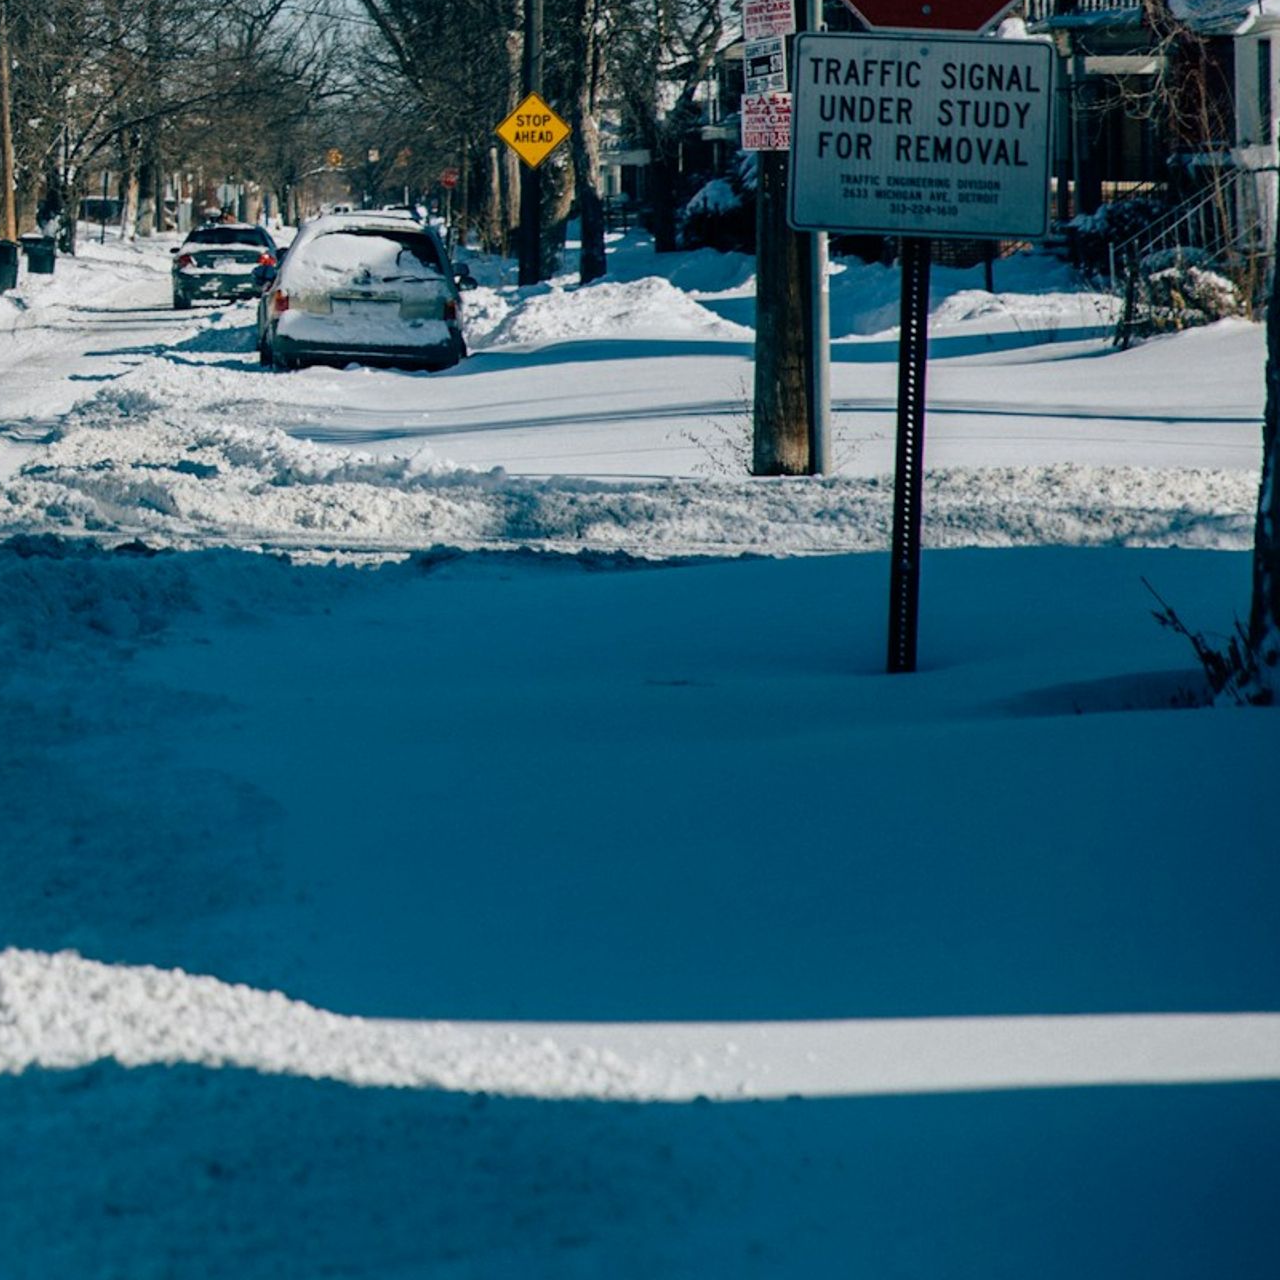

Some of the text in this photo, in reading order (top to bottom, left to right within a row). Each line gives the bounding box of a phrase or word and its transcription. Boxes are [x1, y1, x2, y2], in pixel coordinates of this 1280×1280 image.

[766, 0, 791, 13] CARS
[810, 58, 921, 88] TRAFFIC
[941, 63, 1040, 93] SIGNAL
[819, 95, 1031, 129] UNDER STUDY
[516, 114, 551, 127] STOP
[514, 131, 554, 143] AHEAD
[818, 132, 872, 160] FOR
[895, 136, 1029, 166] REMOVAL
[840, 174, 1001, 190] TRAFFIC ENGINEERING DIVISION
[843, 187, 868, 199] 2633
[875, 190, 923, 201] MICHIGAN
[958, 193, 999, 204] DETROIT
